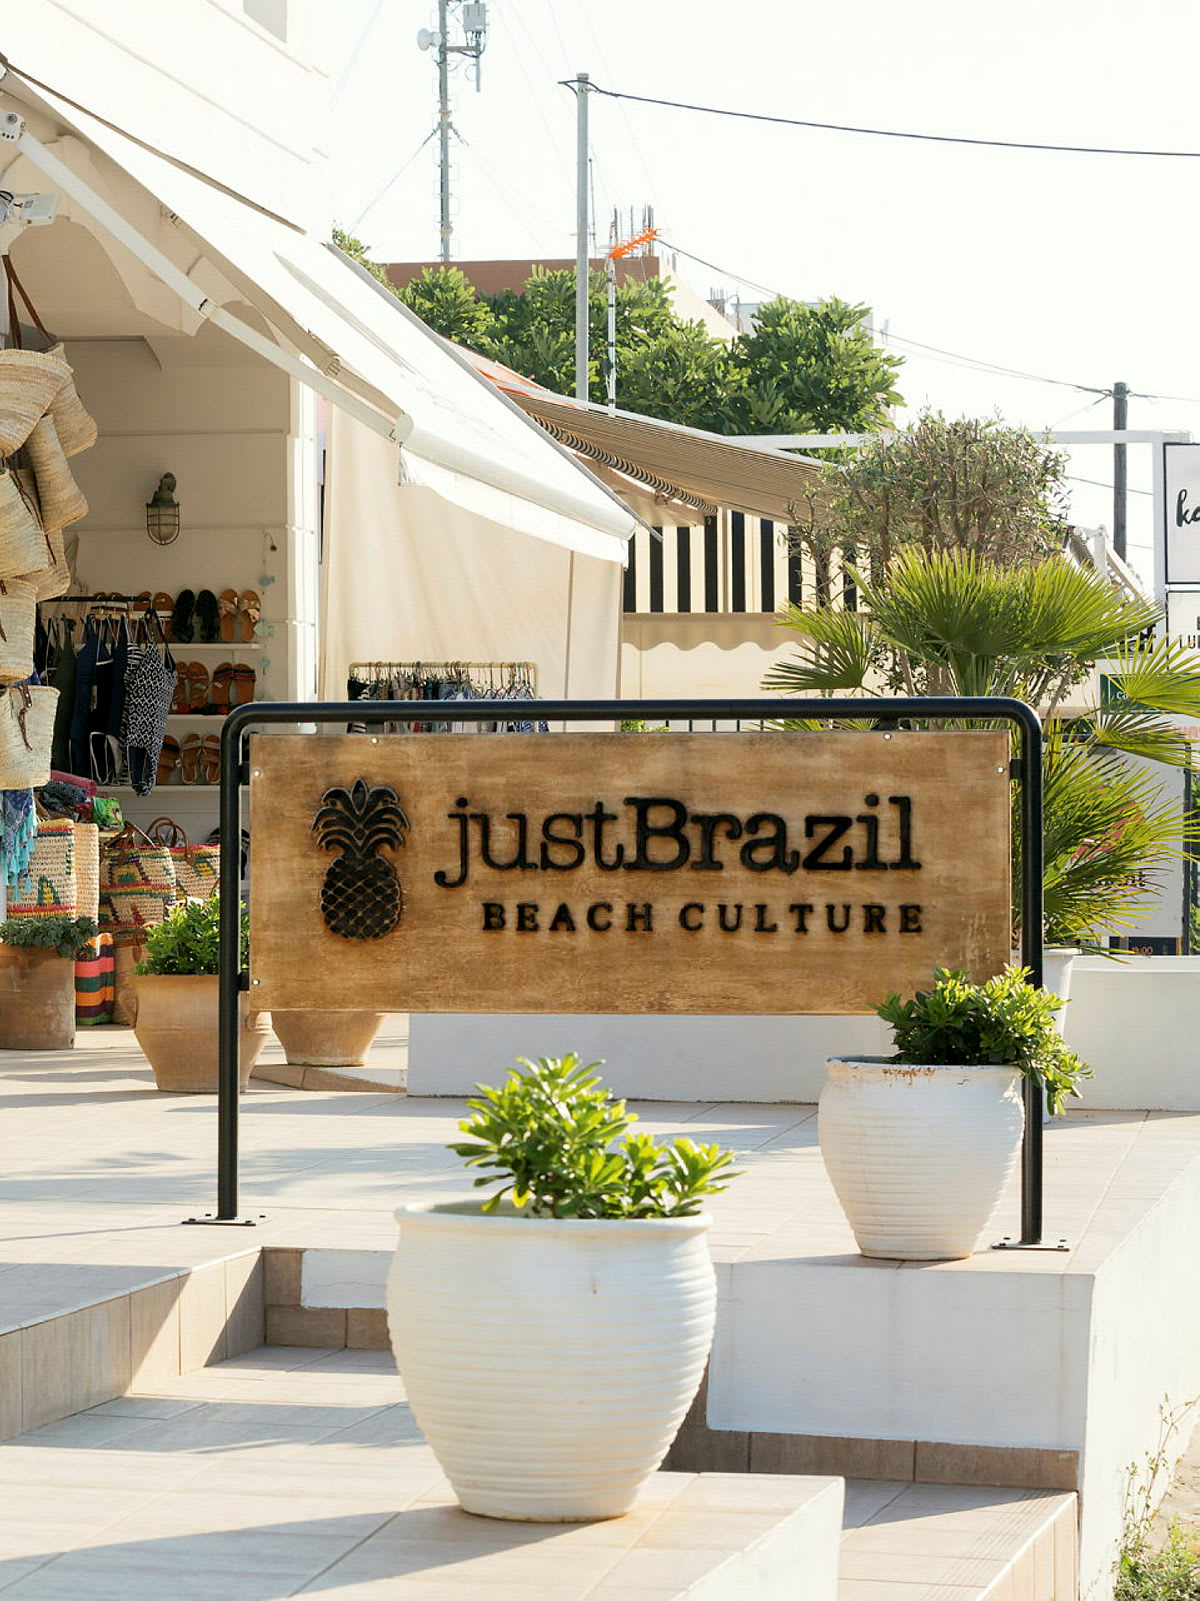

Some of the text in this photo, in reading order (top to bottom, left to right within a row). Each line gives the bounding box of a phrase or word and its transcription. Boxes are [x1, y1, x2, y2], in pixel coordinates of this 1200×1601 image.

[433, 793, 922, 888] justBrazil
[482, 902, 923, 933] BEACH CULTURE
